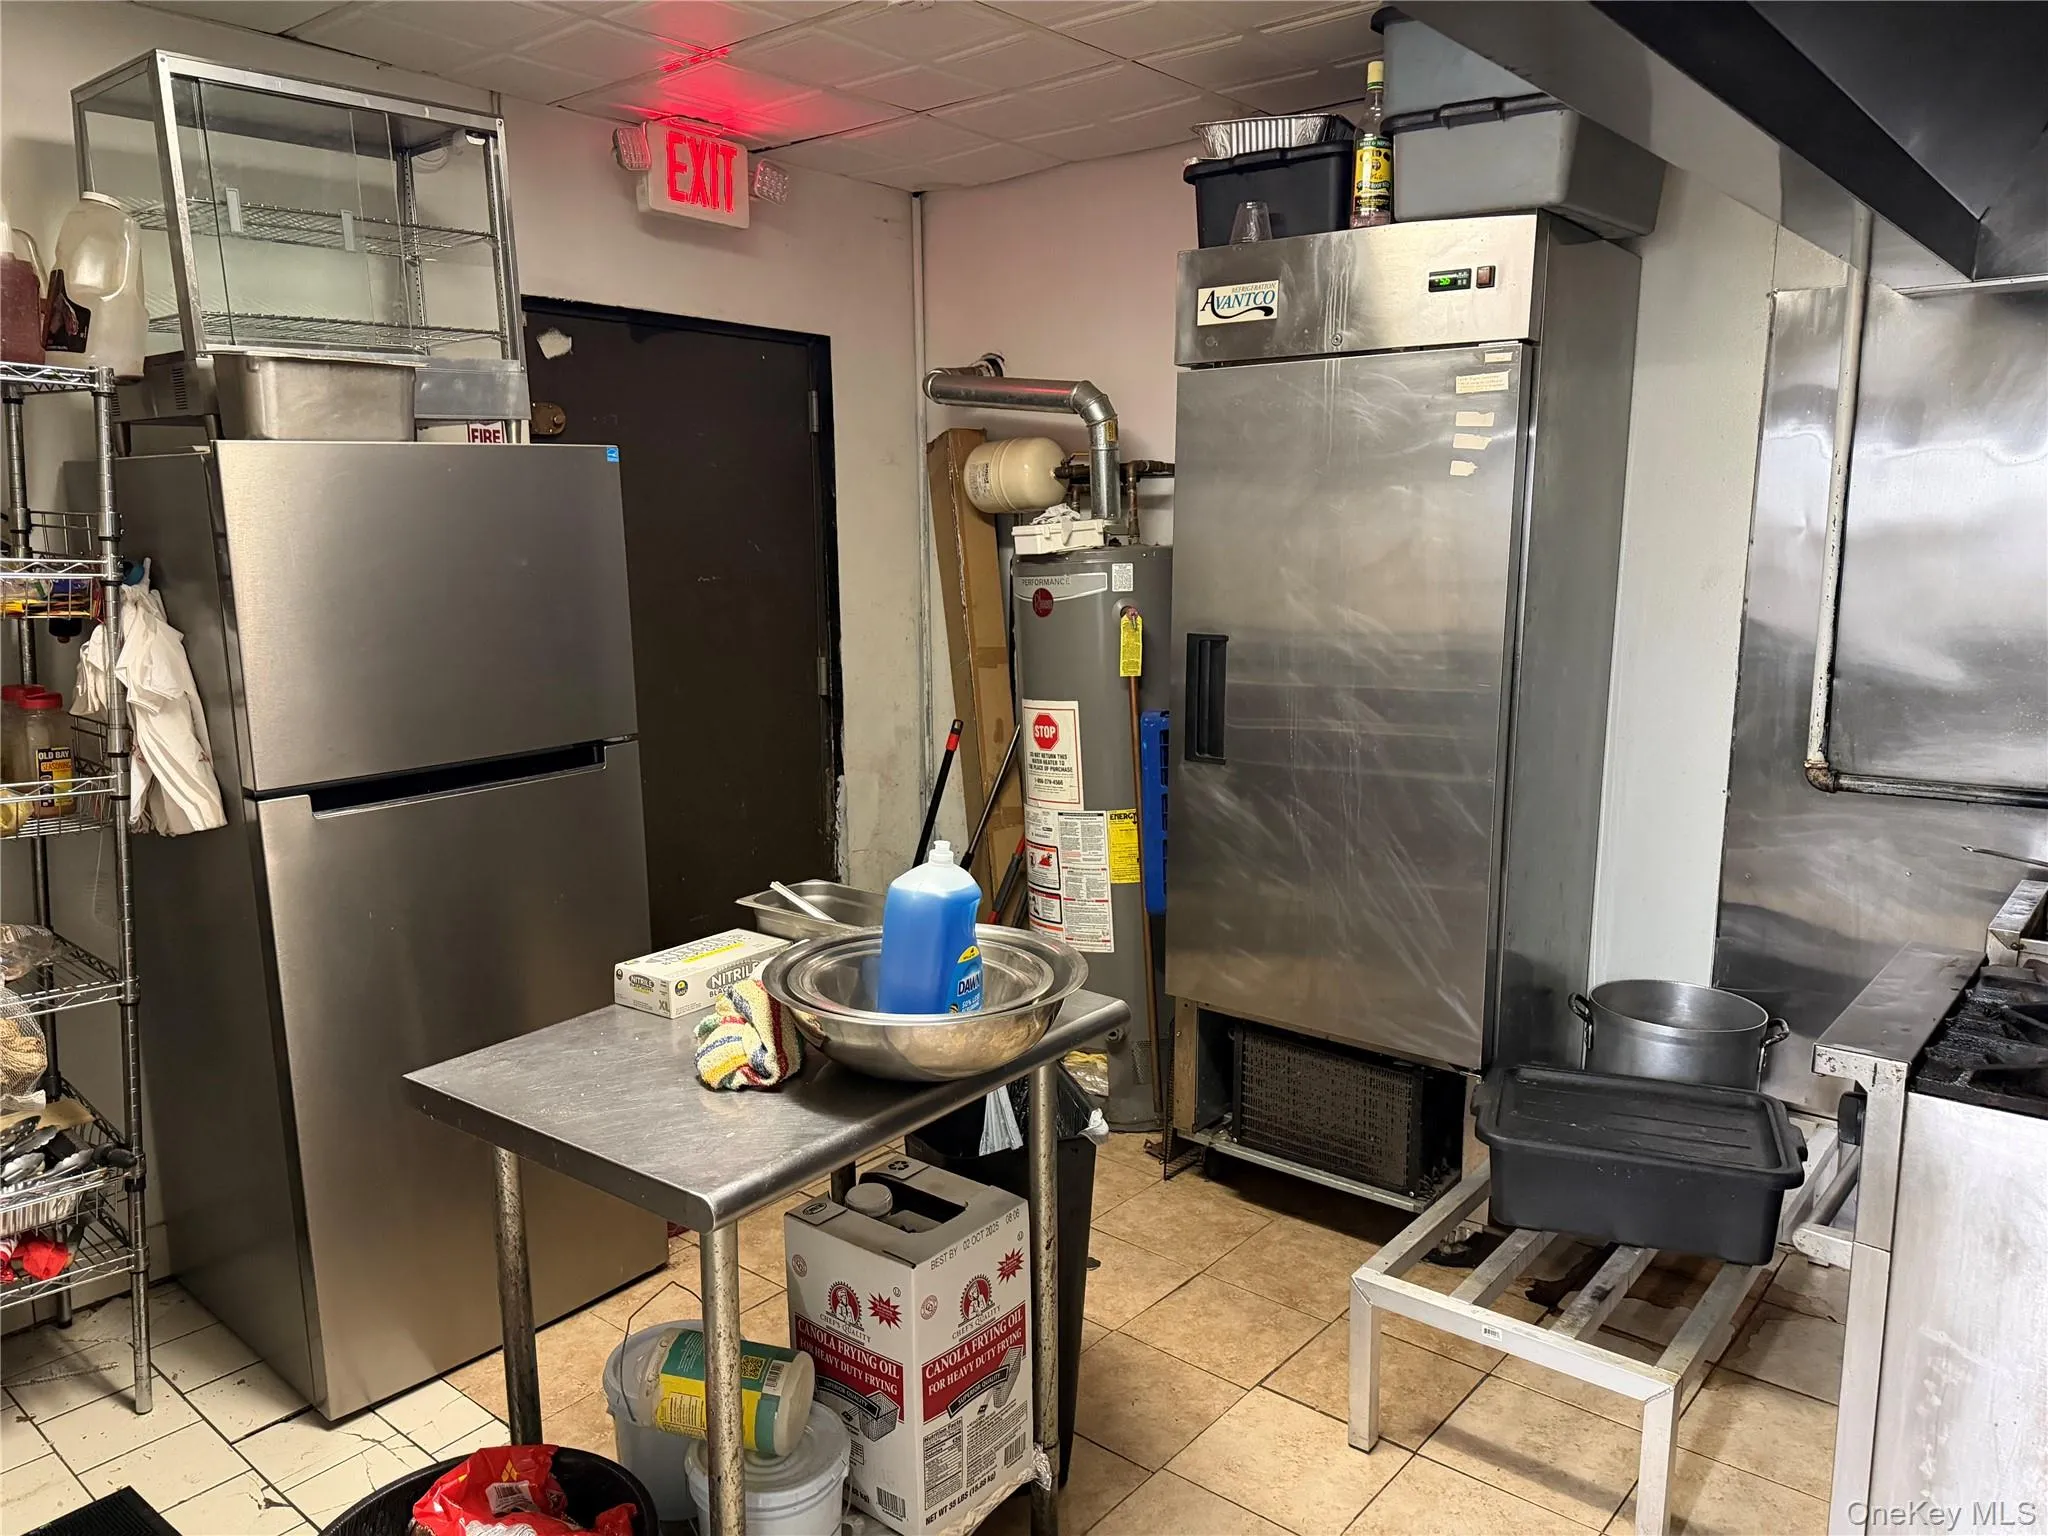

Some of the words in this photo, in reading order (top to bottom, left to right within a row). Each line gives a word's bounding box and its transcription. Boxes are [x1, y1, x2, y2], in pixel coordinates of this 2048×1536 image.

[667, 131, 737, 213] EXIT
[1200, 289, 1275, 312] AVANTCO
[471, 428, 502, 443] FIRE
[1022, 578, 1070, 586] PERFORMANCE
[1034, 725, 1056, 739] STOP
[38, 751, 54, 760] OLD
[55, 751, 69, 759] BAY
[659, 999, 670, 1012] XL
[930, 1252, 947, 1270] BEST
[949, 1246, 958, 1260] BY
[963, 1238, 971, 1250] 02
[971, 1230, 985, 1245] OCT
[975, 1305, 1001, 1326] QUALITY
[841, 1323, 871, 1343] QUALITY
[925, 1344, 970, 1379] CANOLA
[971, 1320, 1007, 1353] FRYING
[1008, 1309, 1024, 1329] OIL
[798, 1320, 836, 1351] CANOLA
[838, 1340, 877, 1370] FRYING
[879, 1360, 900, 1379] OIL
[815, 1348, 840, 1369] HEAVY
[841, 1360, 863, 1380] DUTY
[864, 1372, 898, 1396] FRYING
[928, 1378, 946, 1396] FOR
[947, 1361, 975, 1386] HEAVY
[975, 1346, 997, 1369] DUTY
[997, 1328, 1022, 1355] FRYING
[847, 1390, 868, 1407] QUALITY
[958, 1383, 982, 1405] SUPERIOR
[981, 1372, 1001, 1387] QUALITY
[925, 1511, 938, 1526] NET
[938, 1505, 948, 1518] WT
[948, 1499, 957, 1510] 35
[957, 1490, 969, 1504] LBS
